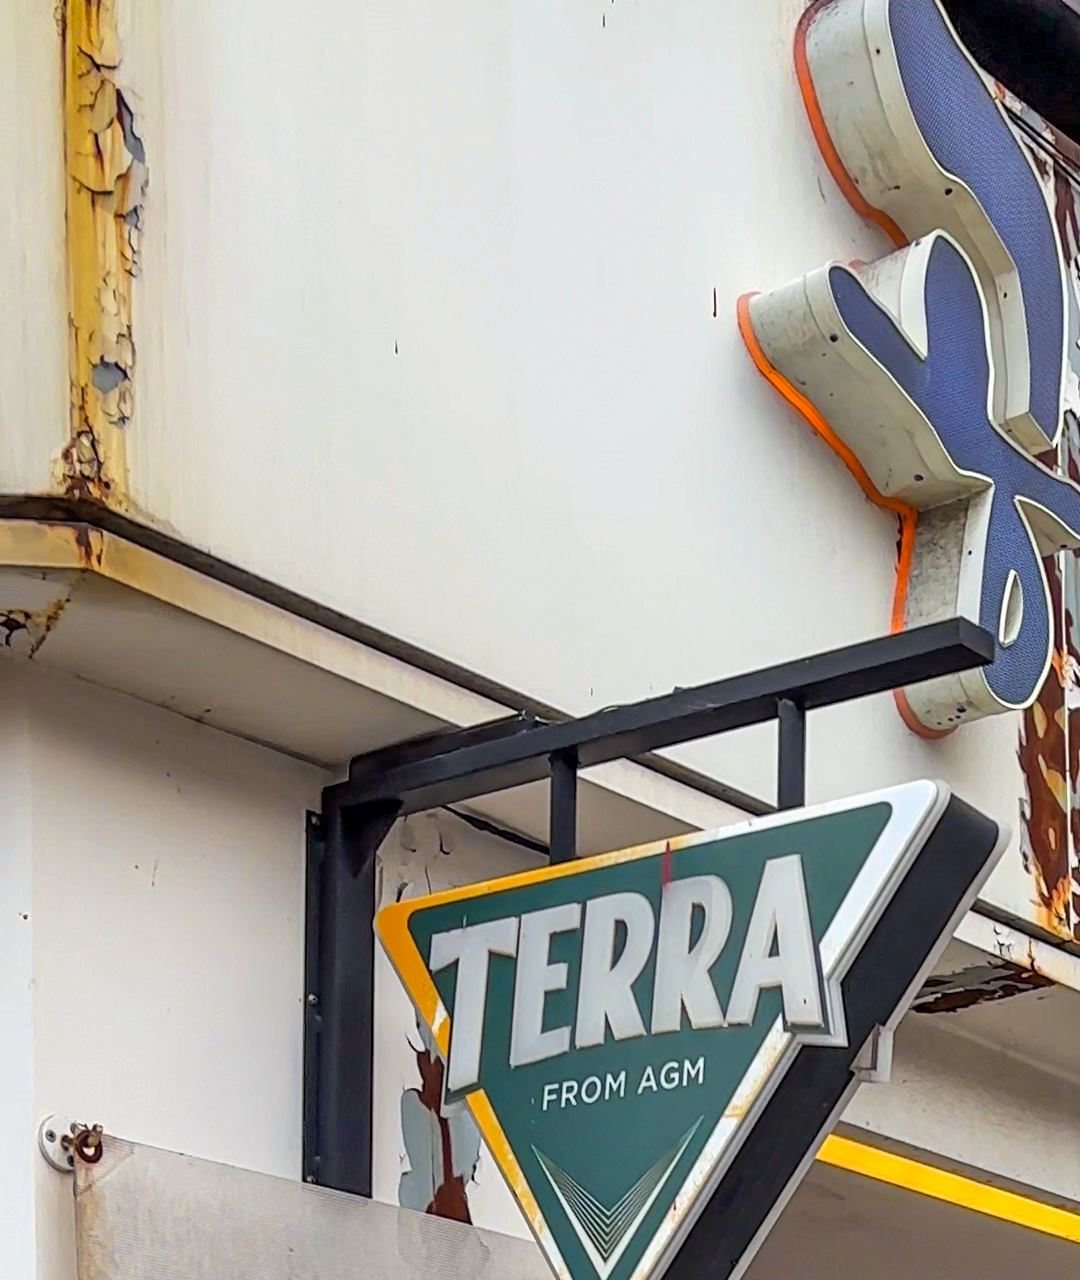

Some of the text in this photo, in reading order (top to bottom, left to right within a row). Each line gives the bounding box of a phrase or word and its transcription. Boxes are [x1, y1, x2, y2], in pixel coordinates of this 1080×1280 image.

[429, 853, 826, 1093] TERRA
[541, 1057, 705, 1112] FROM AGM
